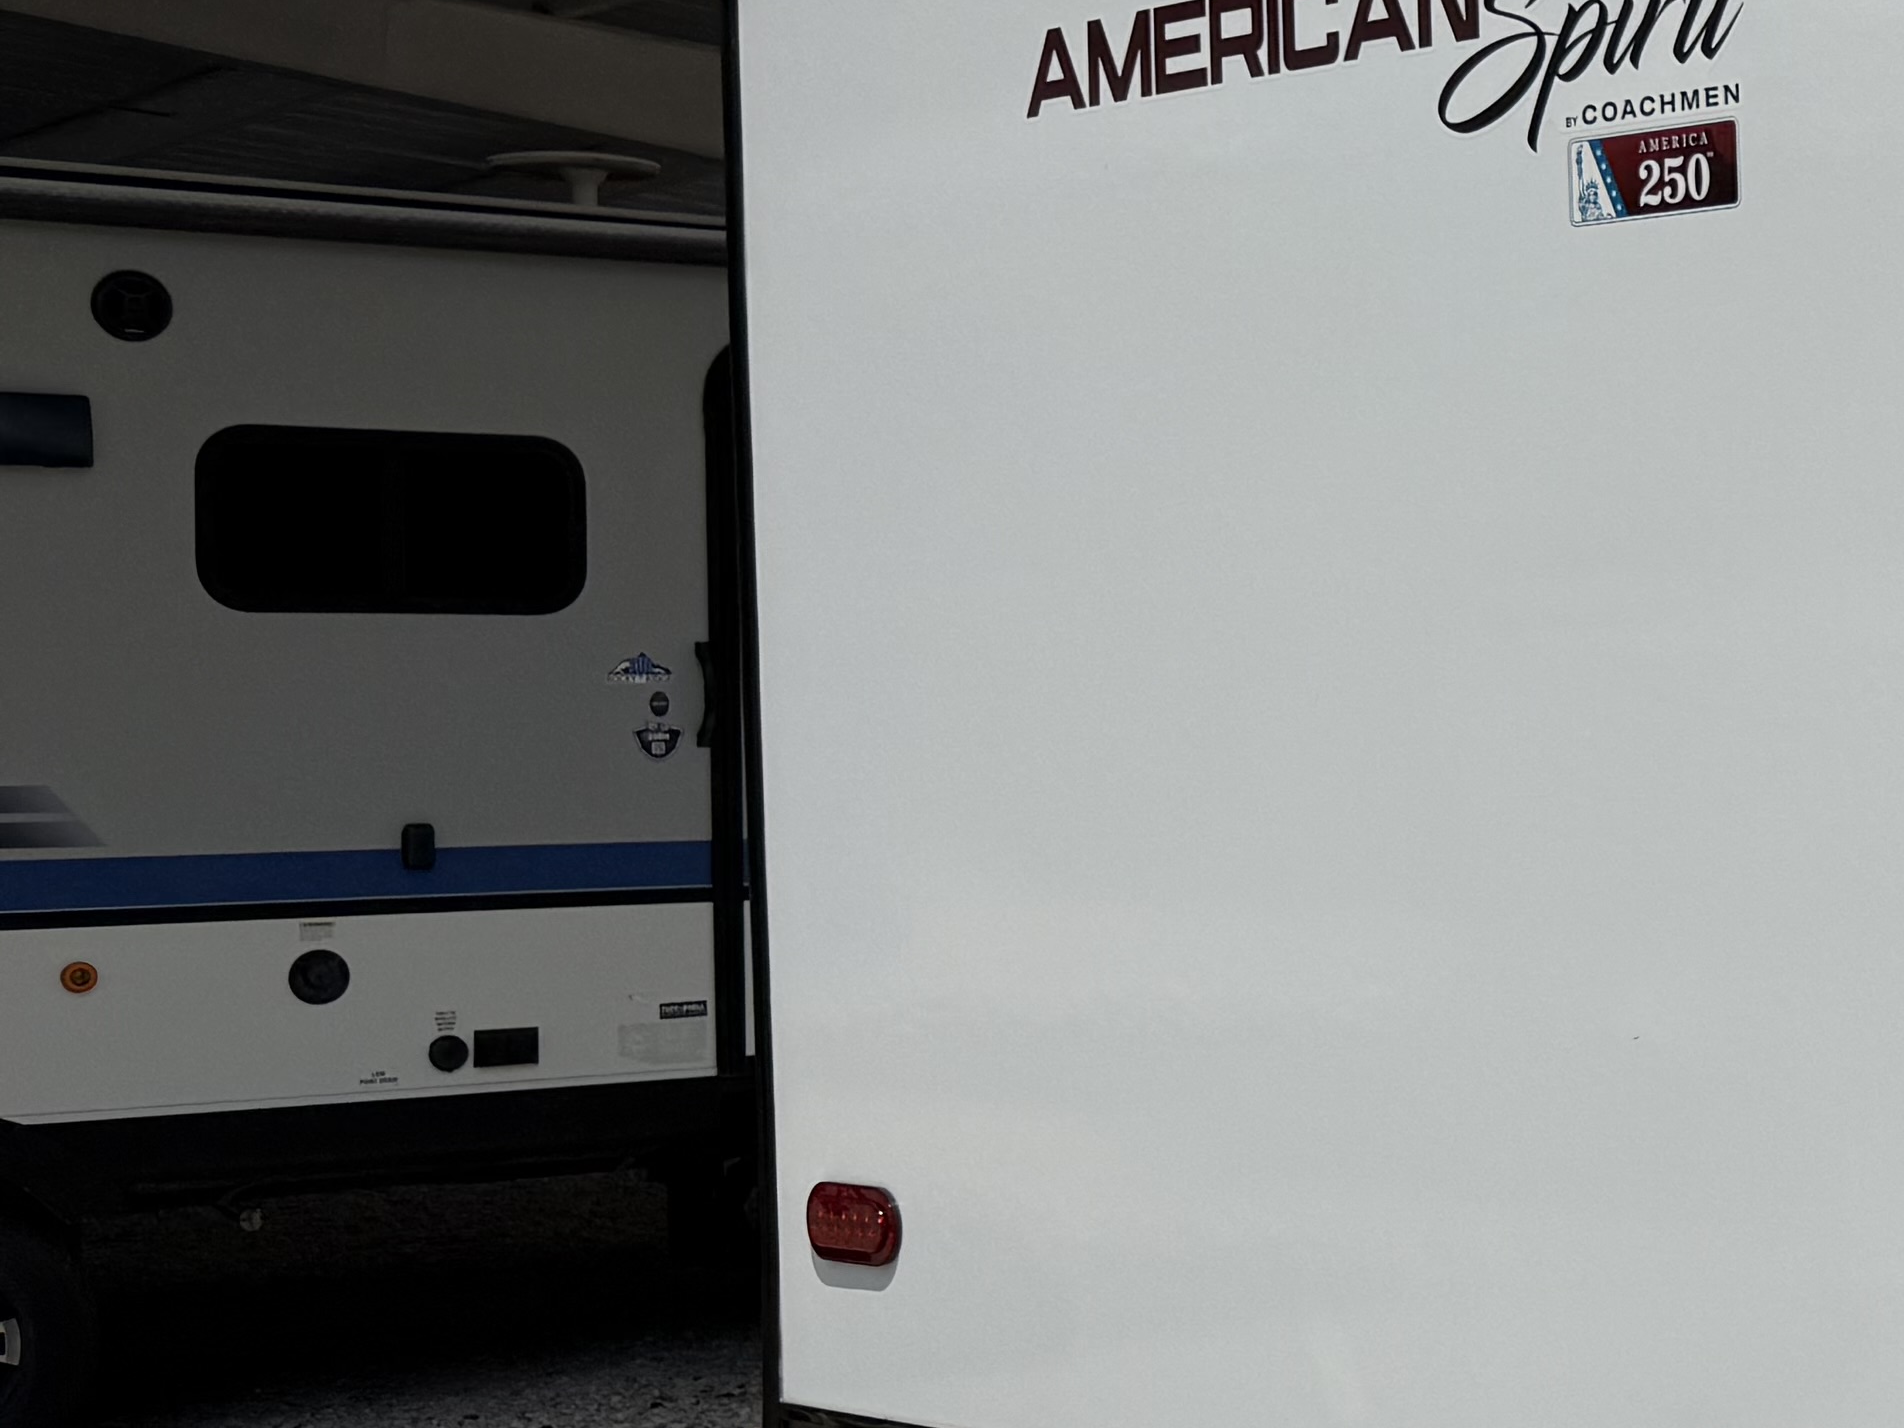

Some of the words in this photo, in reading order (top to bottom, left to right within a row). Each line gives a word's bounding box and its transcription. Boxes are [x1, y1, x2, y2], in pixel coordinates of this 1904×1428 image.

[1565, 115, 1579, 129] BY
[1581, 82, 1741, 125] COACHMEN
[1638, 131, 1709, 154] AMERICA
